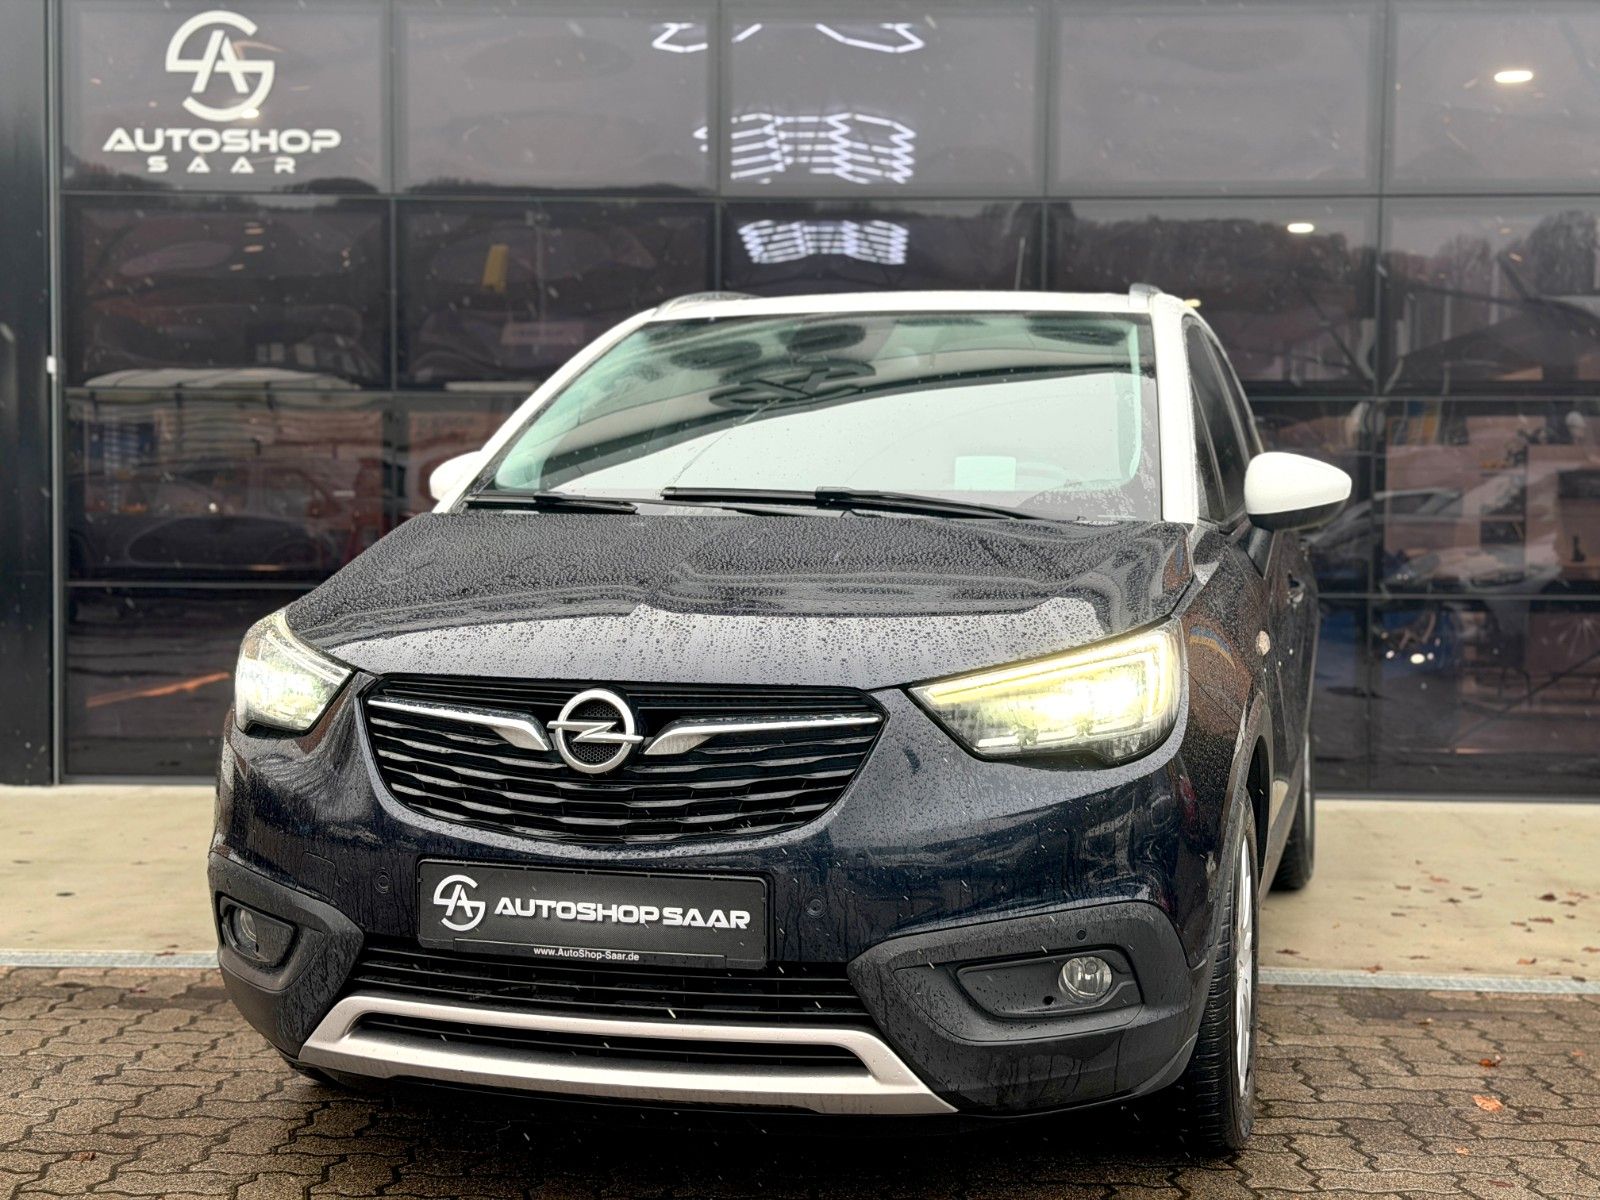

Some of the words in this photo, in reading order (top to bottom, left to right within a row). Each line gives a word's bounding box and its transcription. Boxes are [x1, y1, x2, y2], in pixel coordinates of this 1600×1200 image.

[102, 127, 342, 153] AUTOSHOP
[147, 155, 297, 174] SAAR
[533, 946, 640, 961] www.AutoShop-Saar.de
